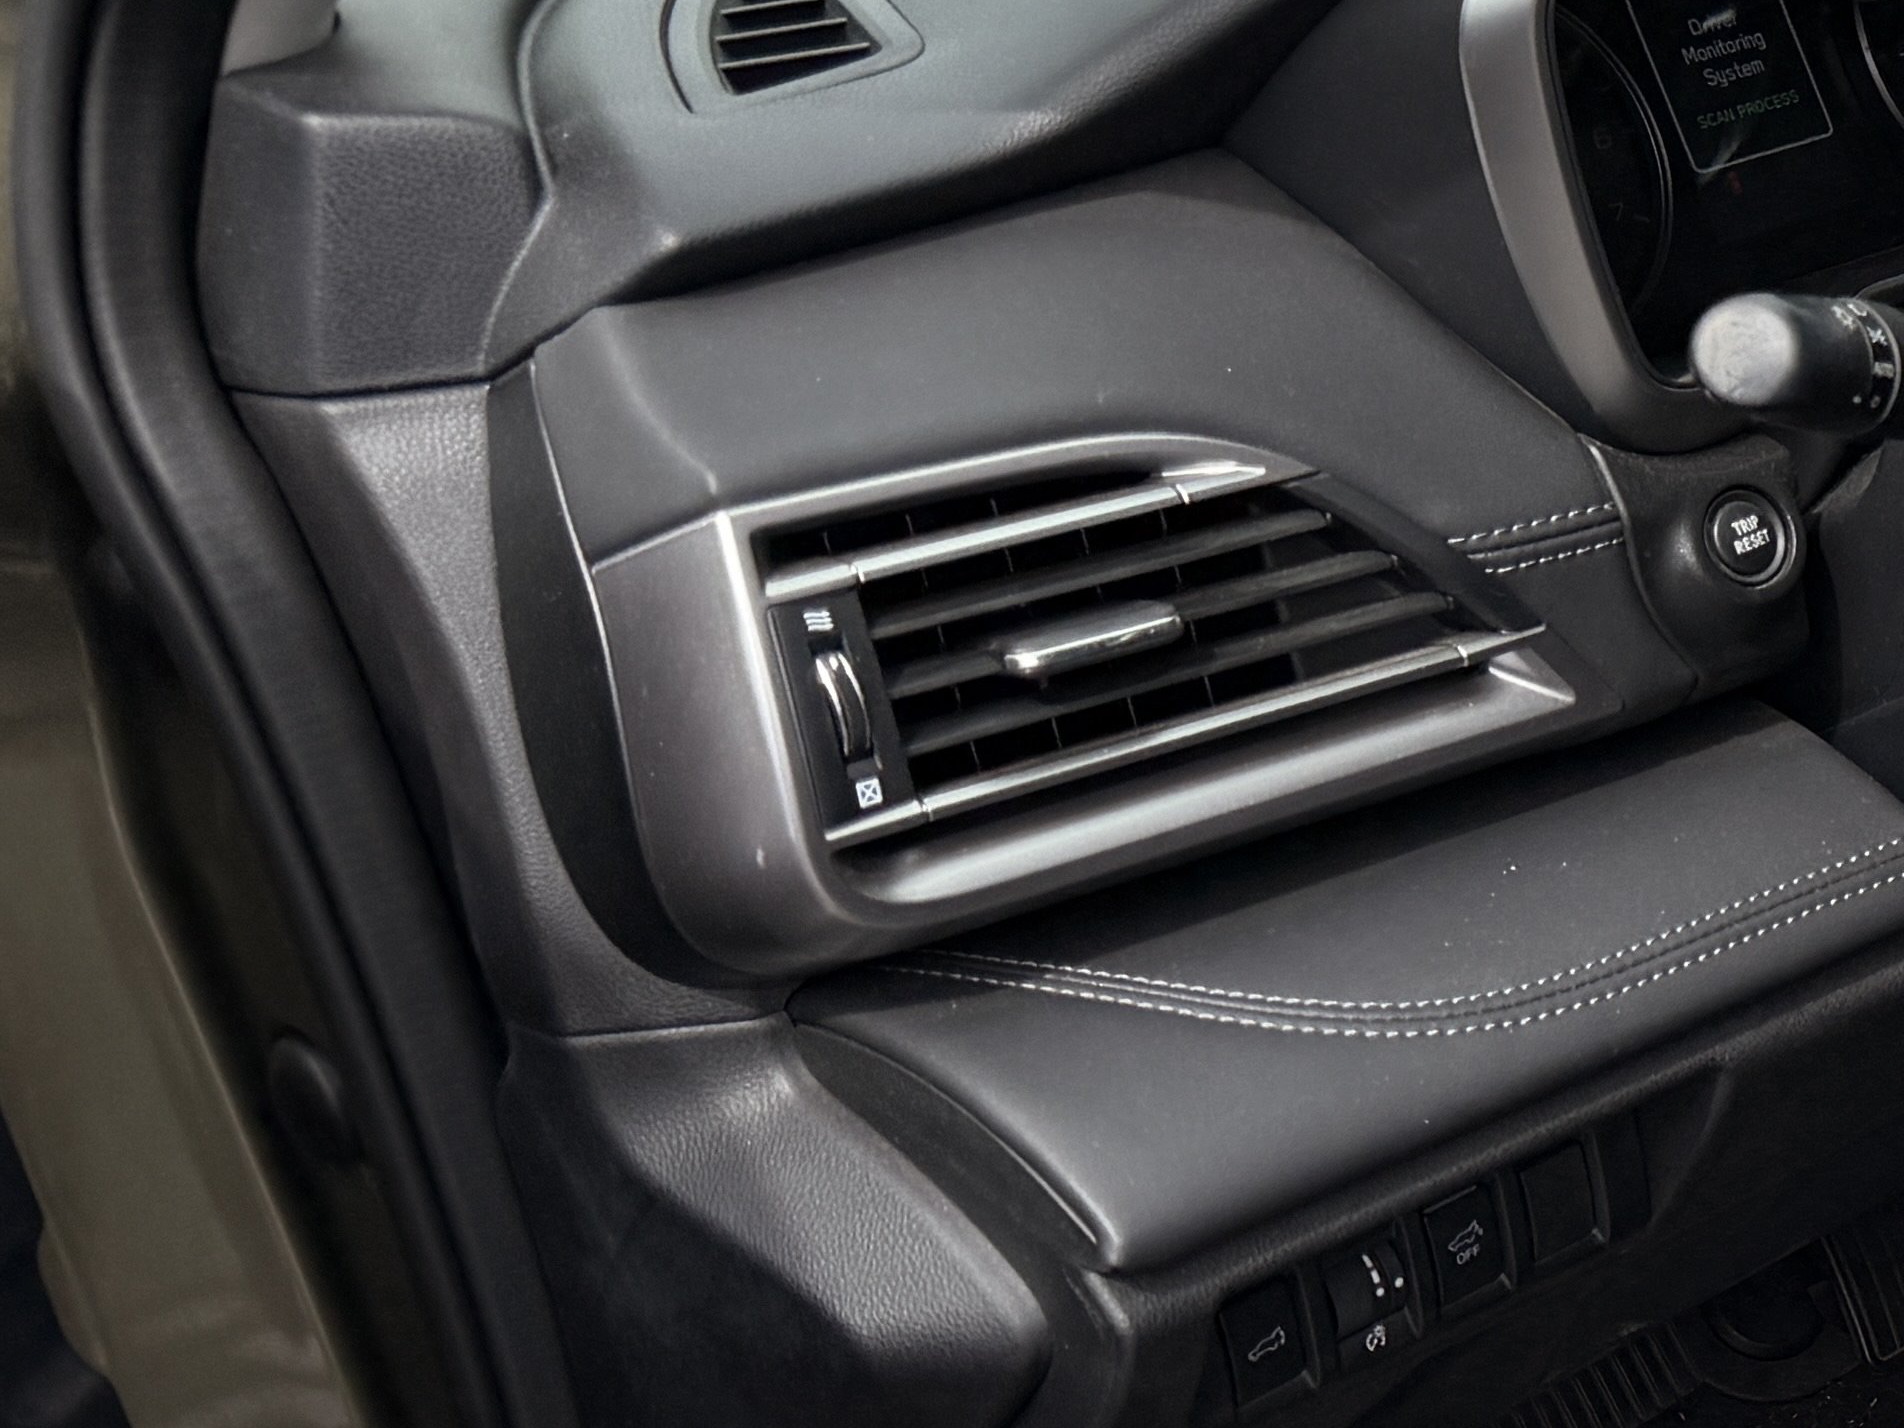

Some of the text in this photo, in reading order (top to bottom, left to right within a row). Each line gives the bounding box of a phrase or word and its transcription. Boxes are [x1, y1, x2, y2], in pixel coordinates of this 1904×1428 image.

[1687, 6, 1738, 36] Driver
[1680, 32, 1767, 65] Monitoring
[1702, 59, 1766, 88] System
[1696, 89, 1801, 130] SCAN PROCESS
[1730, 514, 1759, 537] TRIP
[1733, 528, 1771, 556] RESET
[1456, 1243, 1481, 1266] OFF
